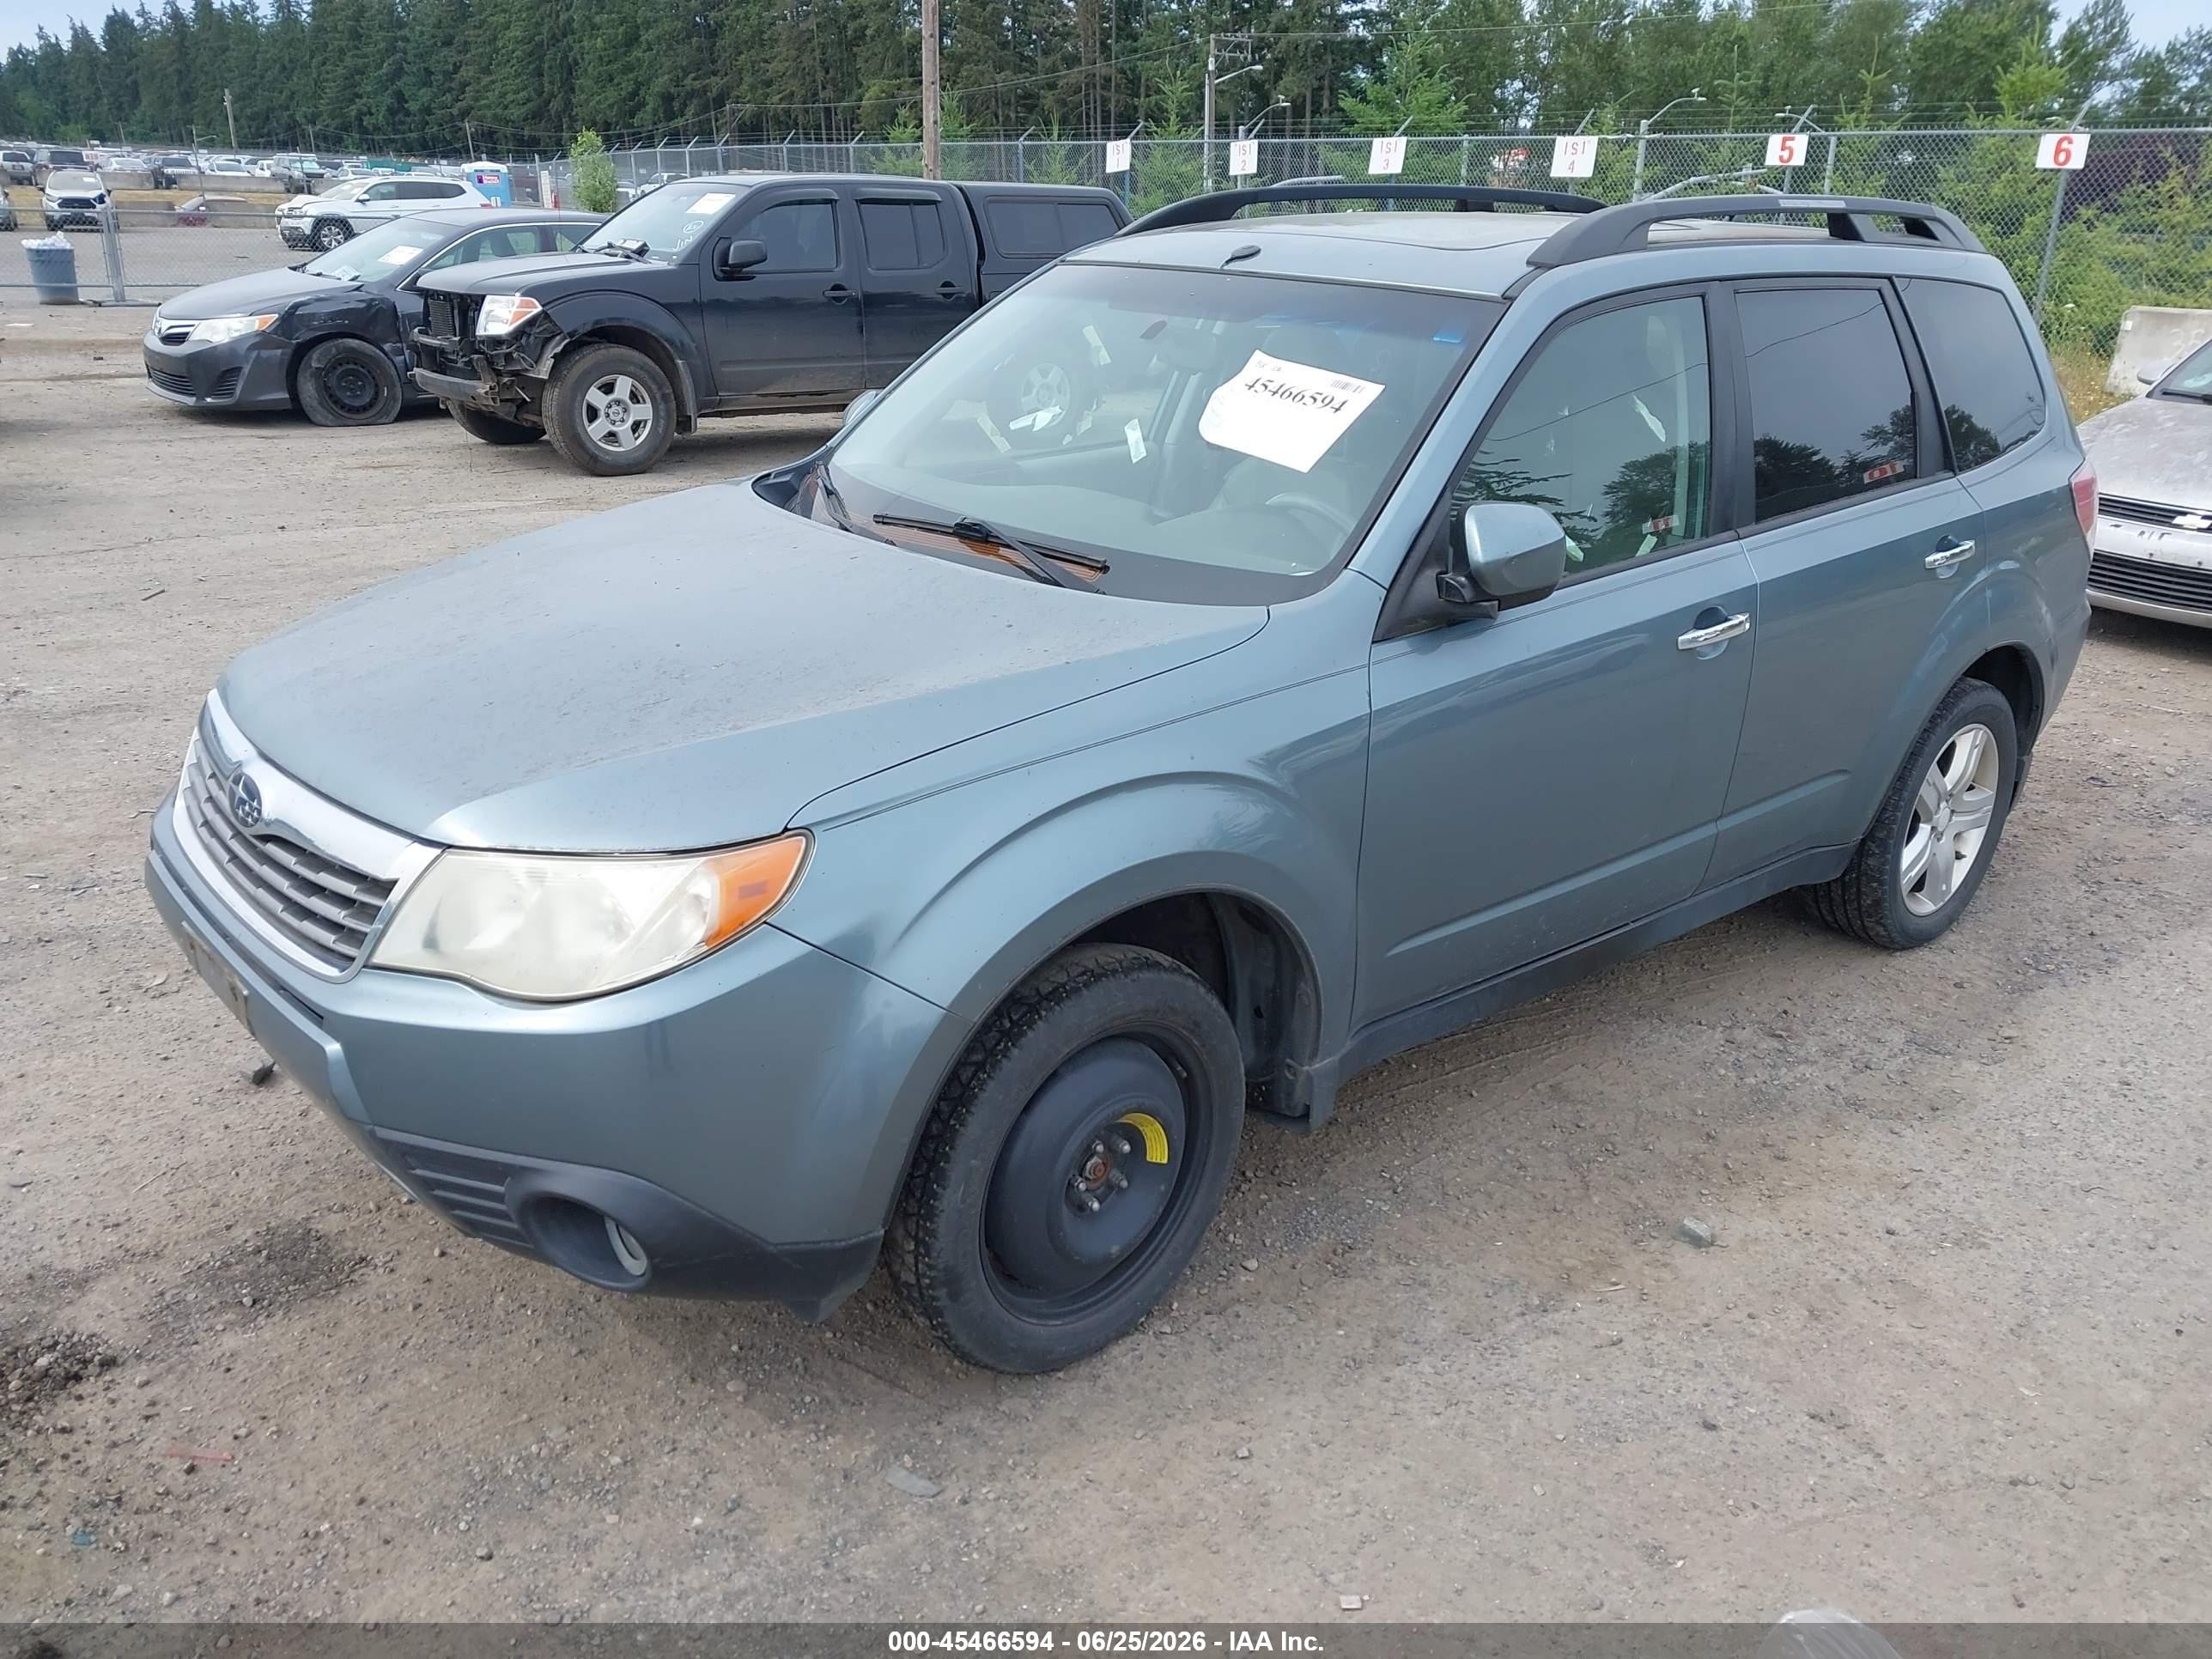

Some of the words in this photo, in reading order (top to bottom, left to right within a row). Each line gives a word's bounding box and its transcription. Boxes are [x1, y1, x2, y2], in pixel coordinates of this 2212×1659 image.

[1779, 137, 1796, 163] 5
[2053, 136, 2074, 167] 6
[1241, 159, 1247, 172] 2
[1382, 158, 1389, 171] 3
[1568, 159, 1575, 173] 4
[1244, 376, 1349, 414] 45466594
